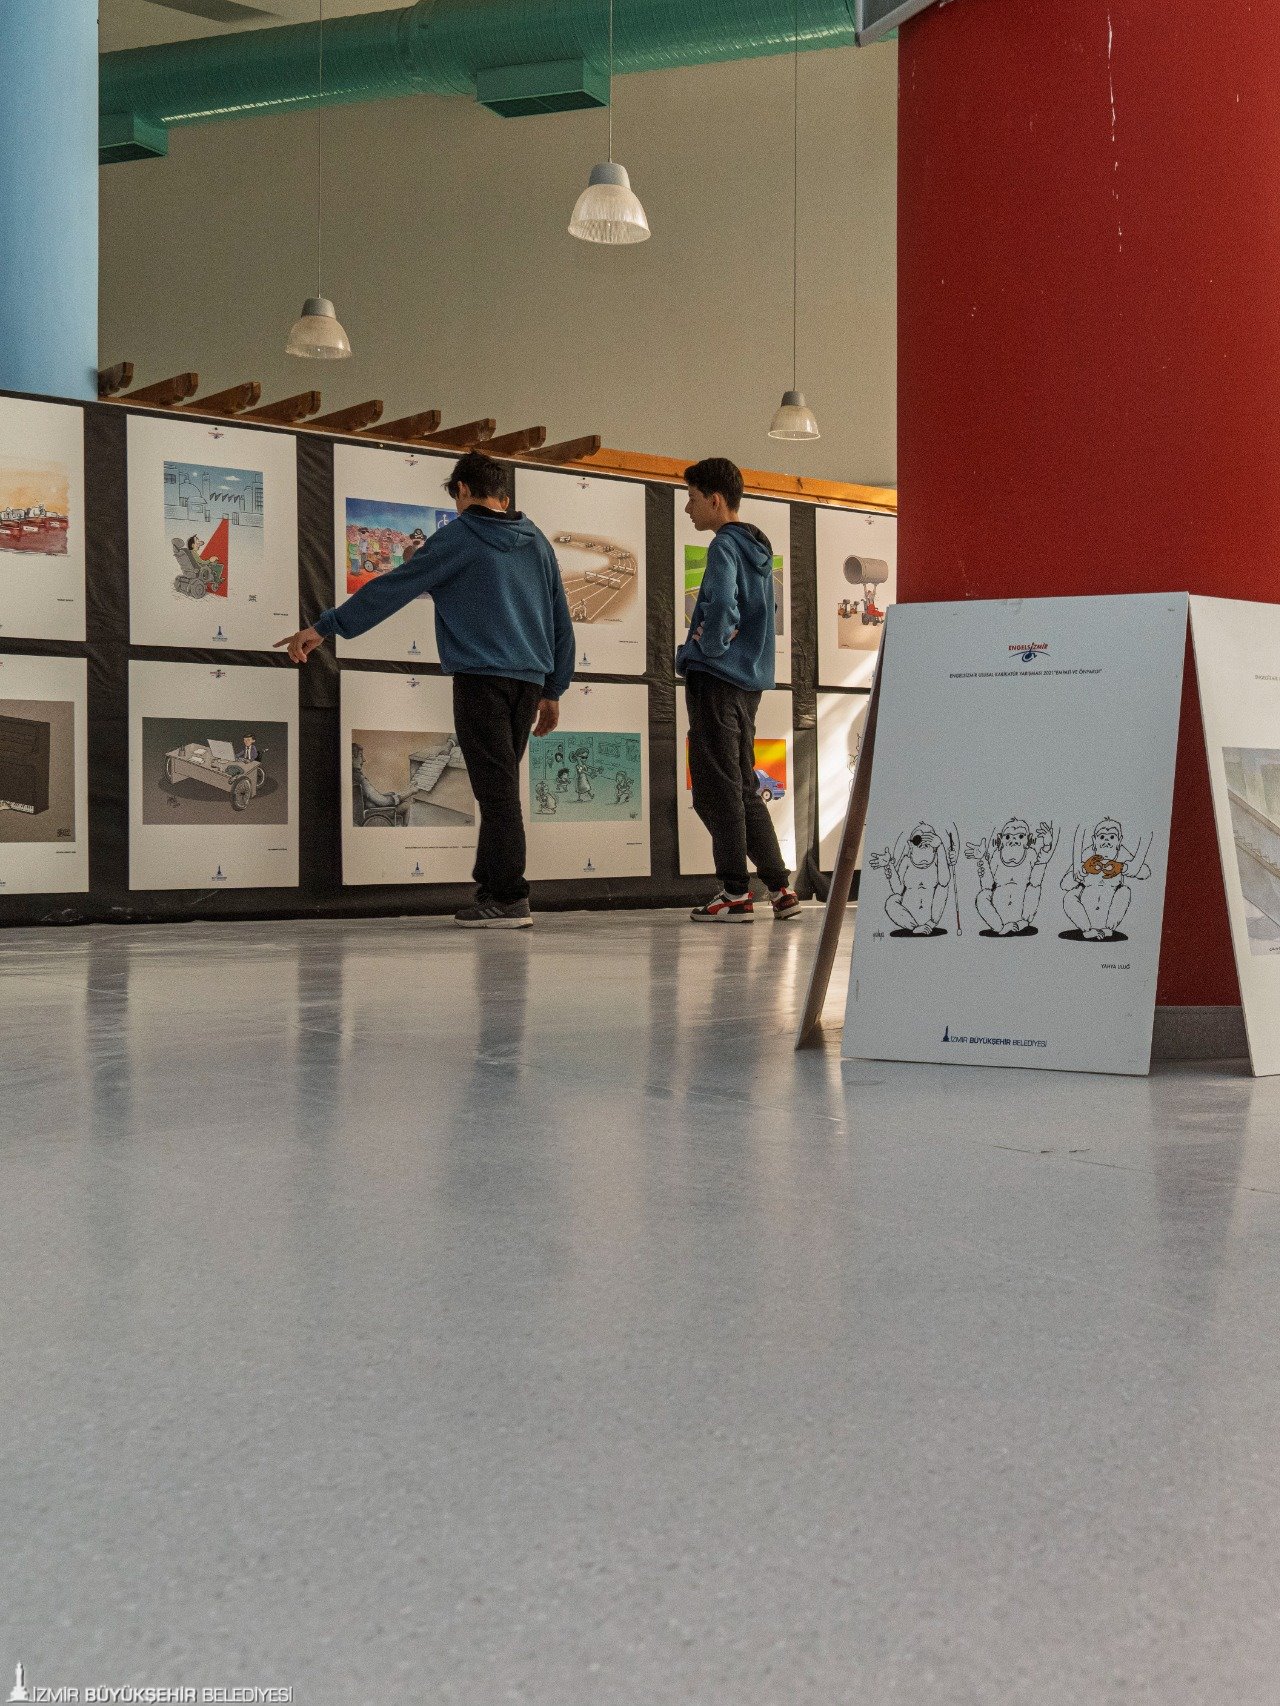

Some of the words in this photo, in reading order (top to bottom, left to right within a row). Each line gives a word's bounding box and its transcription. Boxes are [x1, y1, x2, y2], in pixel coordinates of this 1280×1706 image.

[950, 1035, 968, 1043] İZMİR
[969, 1036, 1011, 1046] BÜYÜKŞEHİR
[1012, 1039, 1048, 1048] BELEDİYESİ
